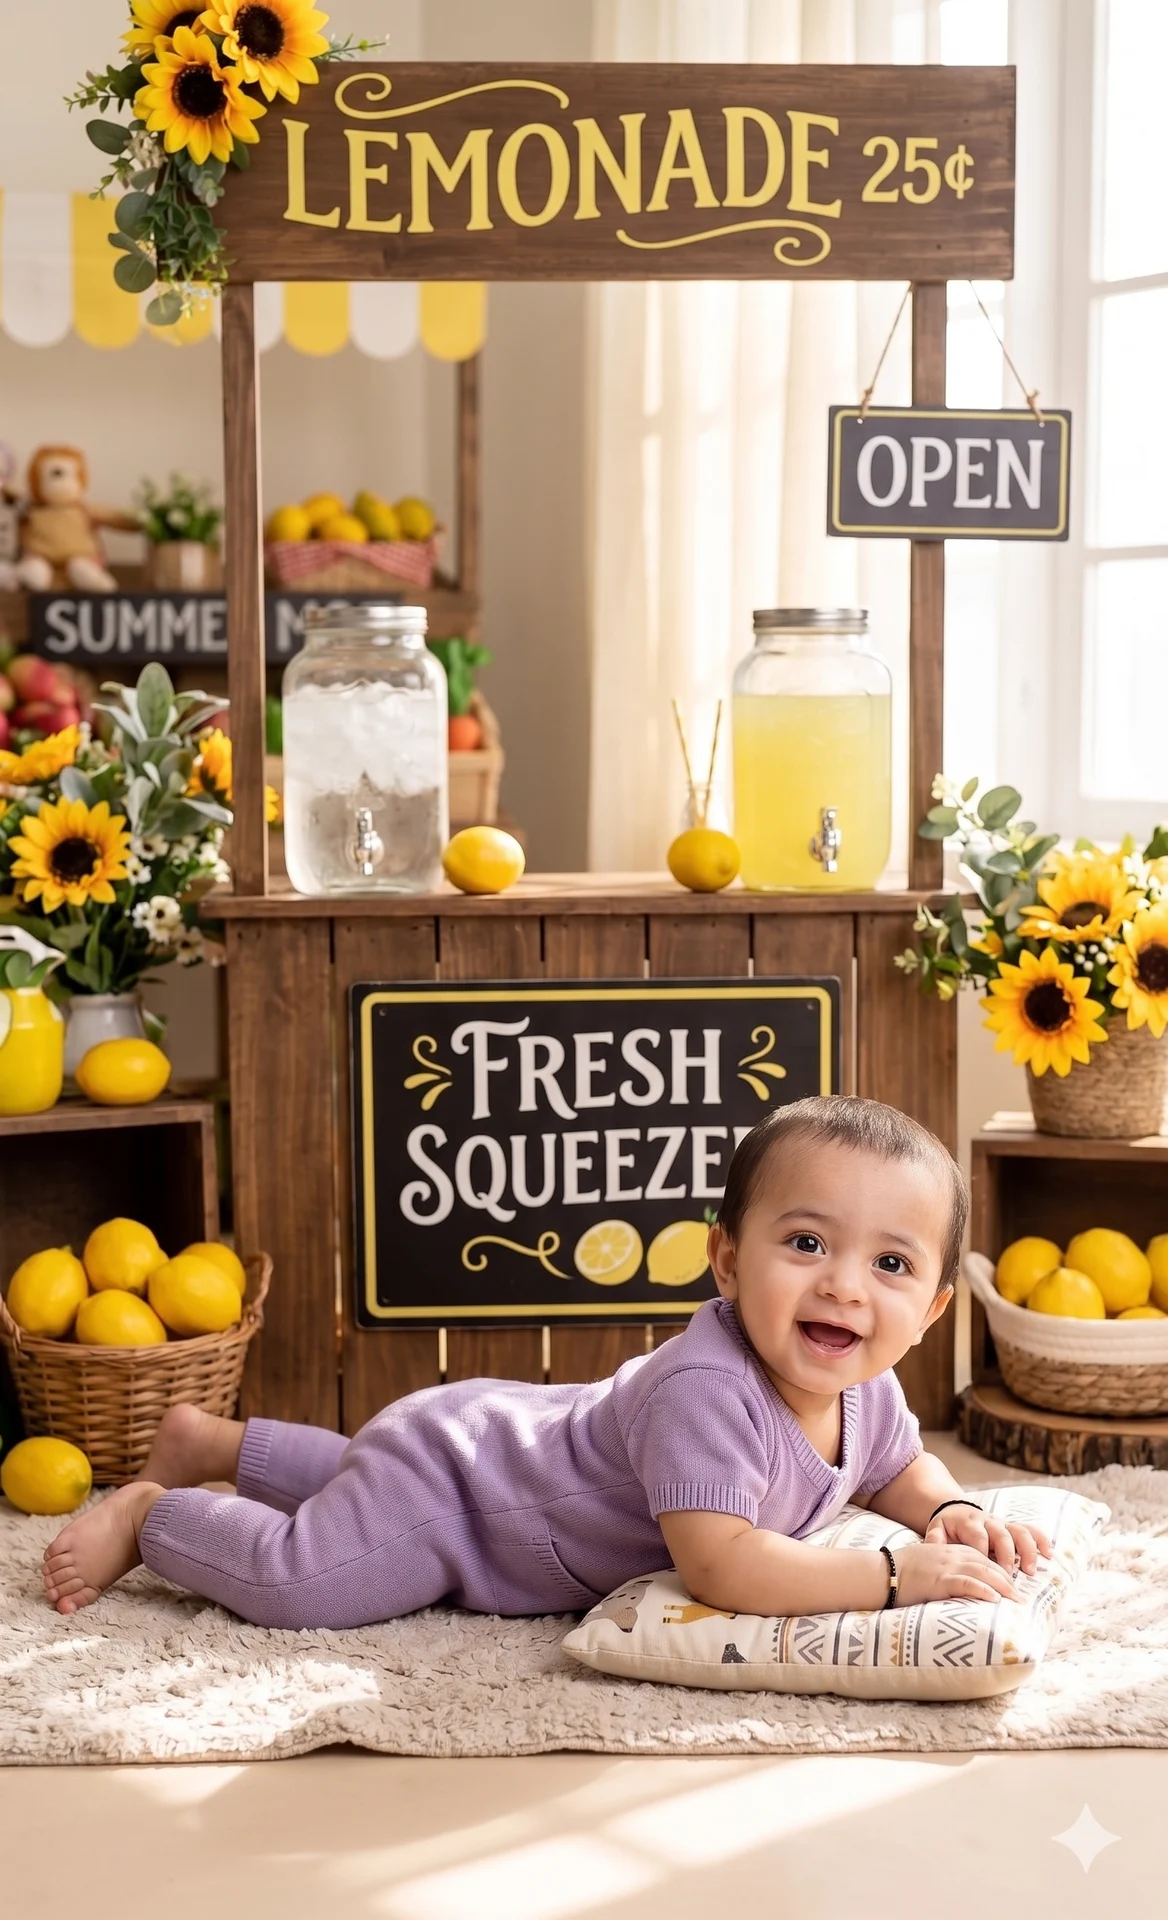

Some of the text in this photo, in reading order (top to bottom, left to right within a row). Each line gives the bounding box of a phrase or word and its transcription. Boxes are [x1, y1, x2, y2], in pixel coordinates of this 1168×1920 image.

[281, 106, 975, 233] LEMONADE 25¢
[856, 434, 1045, 510] OPEN
[45, 600, 228, 654] SUMME
[450, 1016, 723, 1120] FRESH
[399, 1124, 757, 1226] SQUEEZE
